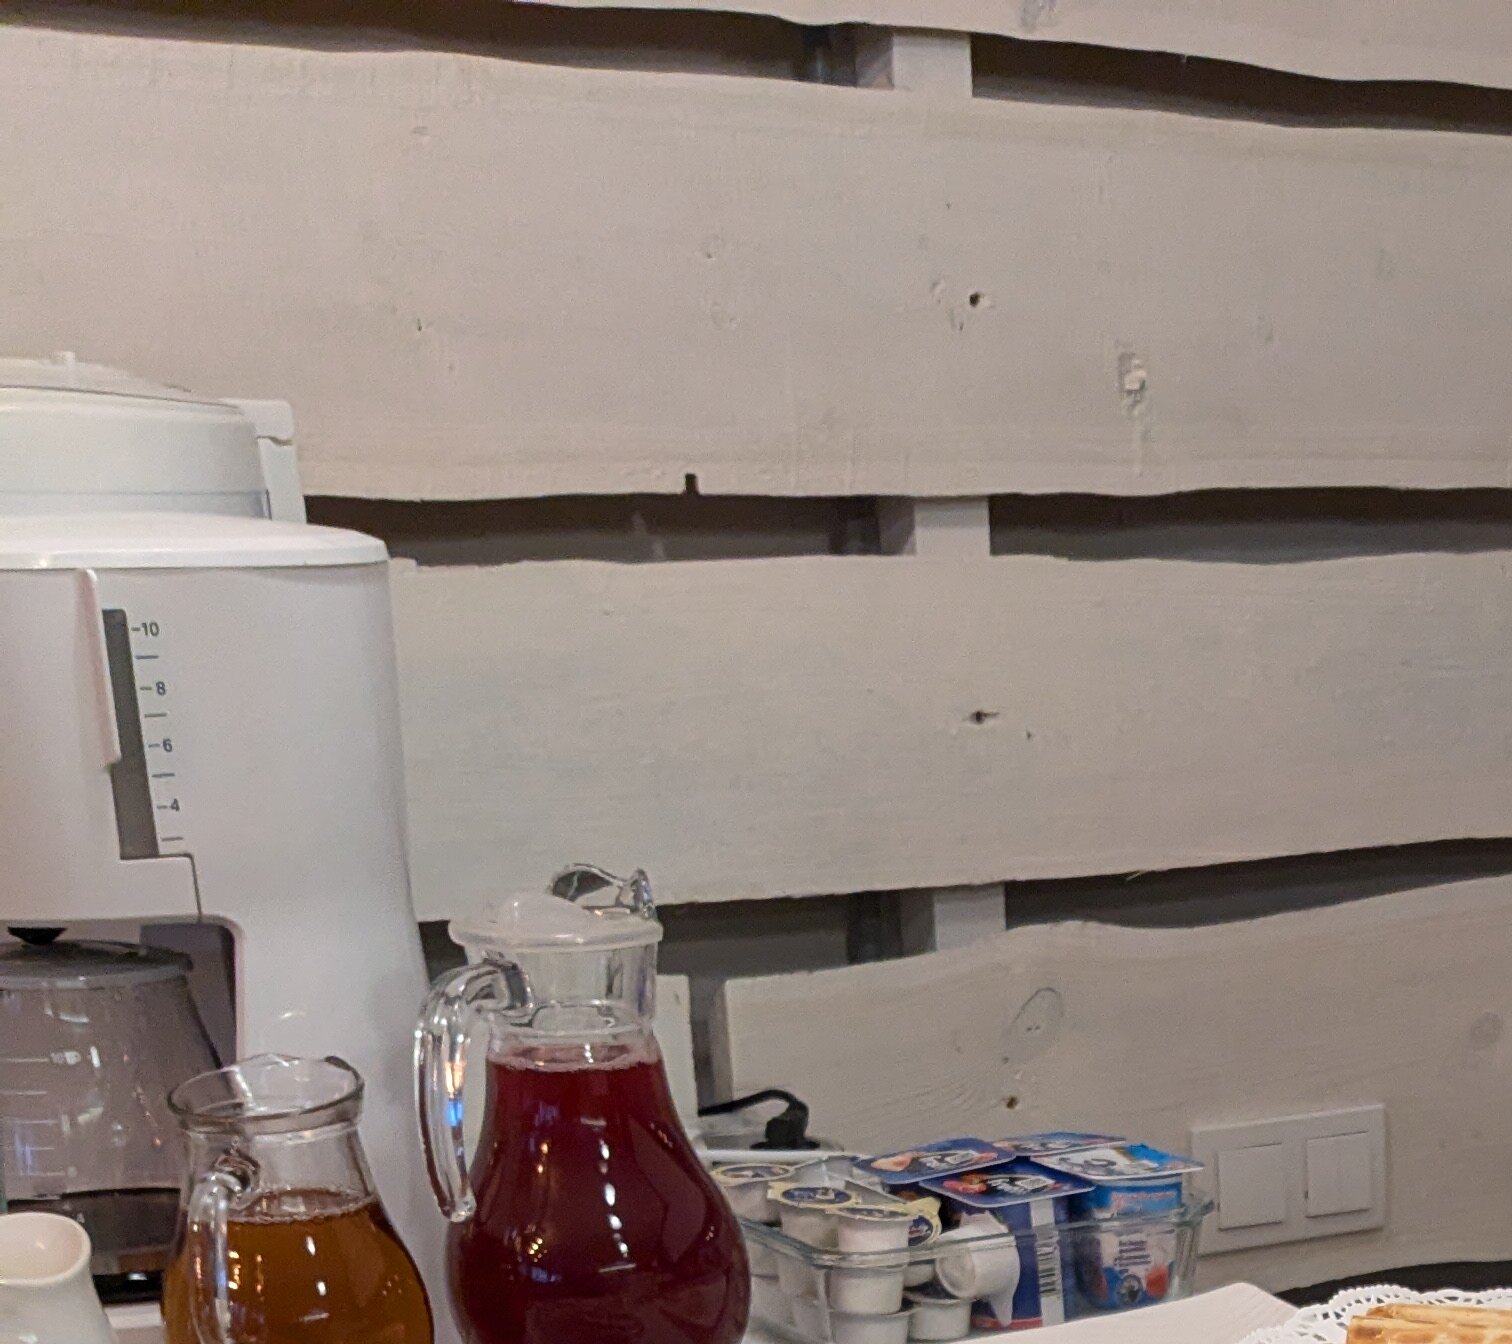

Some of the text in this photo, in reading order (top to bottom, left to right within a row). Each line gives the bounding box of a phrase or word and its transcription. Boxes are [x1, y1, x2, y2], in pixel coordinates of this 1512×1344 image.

[141, 622, 160, 637] 10
[155, 681, 166, 696] 8
[162, 738, 173, 753] 6
[170, 798, 180, 813] 4
